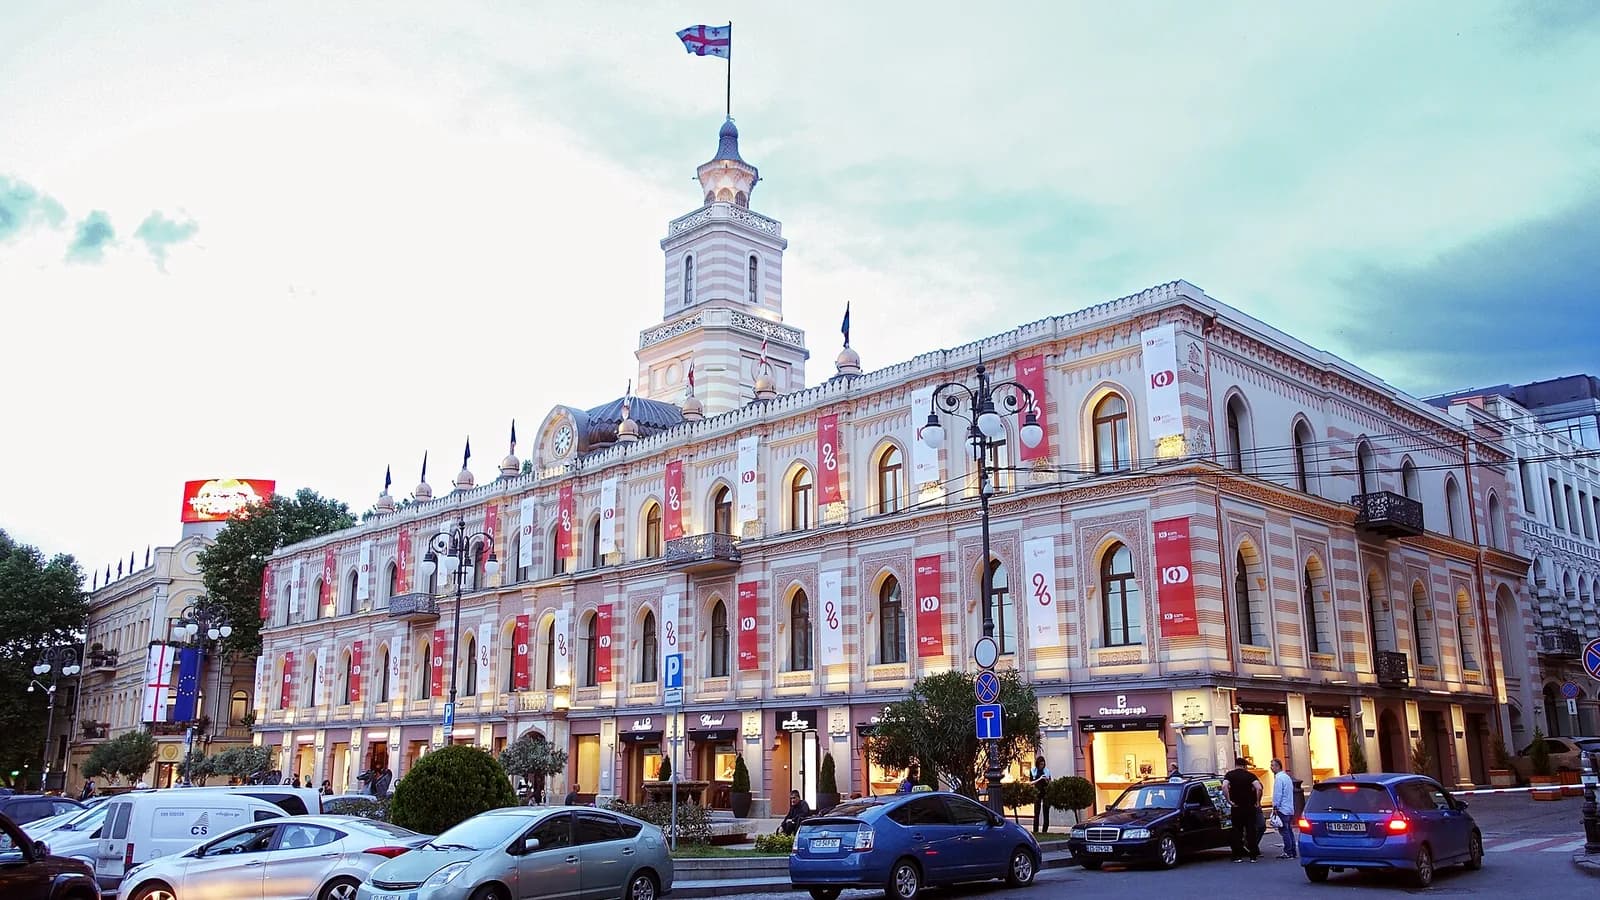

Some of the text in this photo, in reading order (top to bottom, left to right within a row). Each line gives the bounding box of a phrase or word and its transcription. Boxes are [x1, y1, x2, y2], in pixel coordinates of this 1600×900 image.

[1151, 370, 1175, 389] 100
[822, 443, 837, 471] 26
[669, 486, 680, 511] 26
[1162, 565, 1189, 585] 100
[1032, 573, 1051, 606] 26
[920, 596, 939, 613] 100
[742, 617, 756, 632] 100
[825, 601, 839, 630] 26
[666, 620, 676, 646] 26
[558, 633, 567, 656] 26
[667, 656, 680, 686] P
[445, 704, 451, 724] P
[1099, 705, 1147, 716] Chronograph
[191, 826, 208, 836] CS
